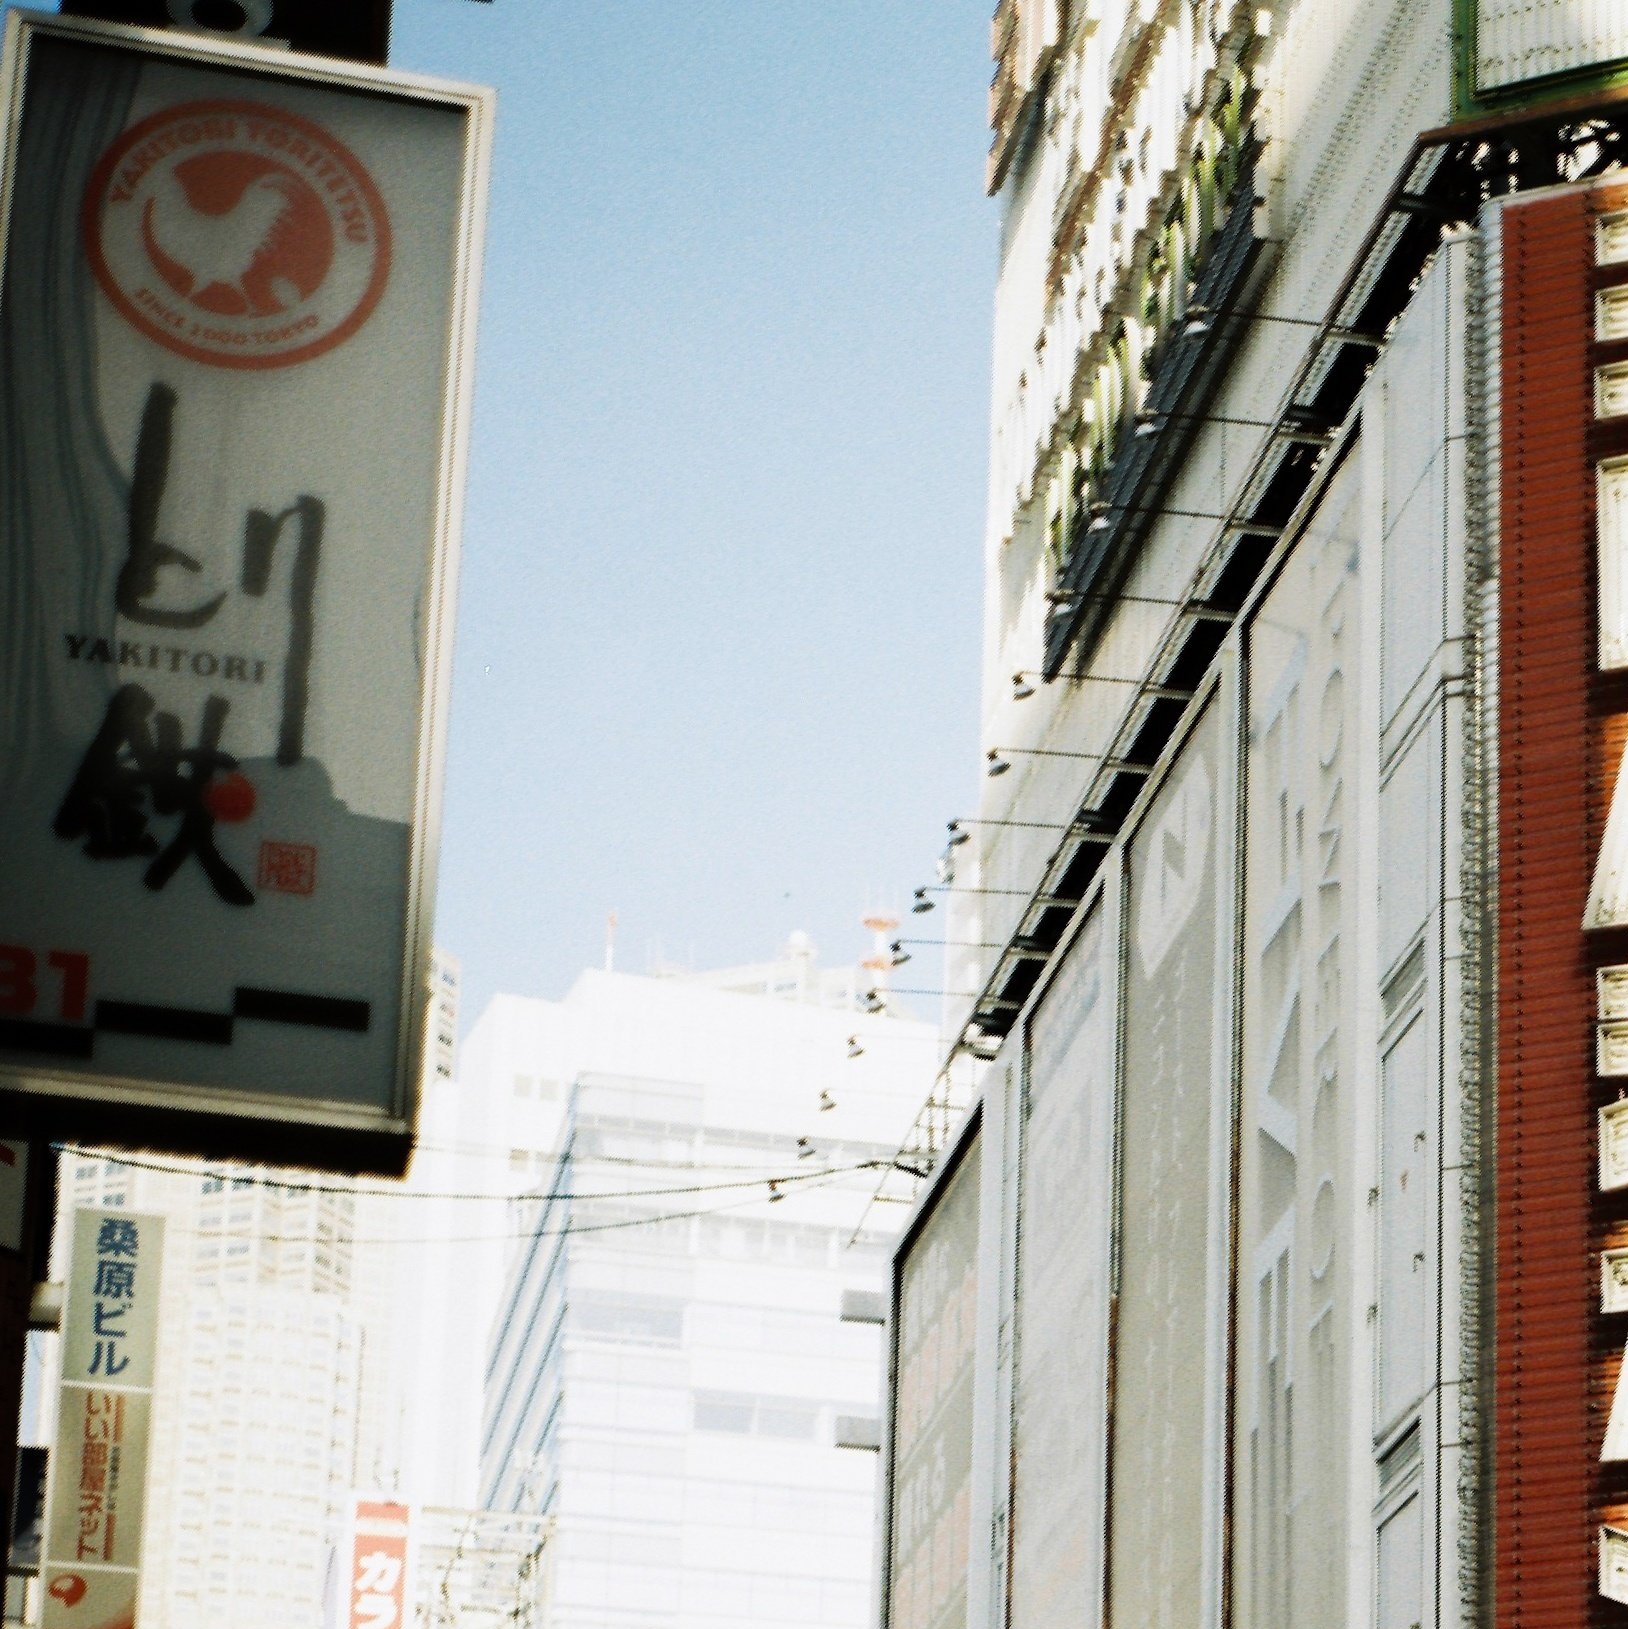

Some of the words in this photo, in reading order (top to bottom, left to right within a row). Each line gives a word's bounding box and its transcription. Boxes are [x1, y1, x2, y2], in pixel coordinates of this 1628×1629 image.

[64, 633, 267, 685] YAKITORI
[88, 1217, 141, 1378] 桑原ビル
